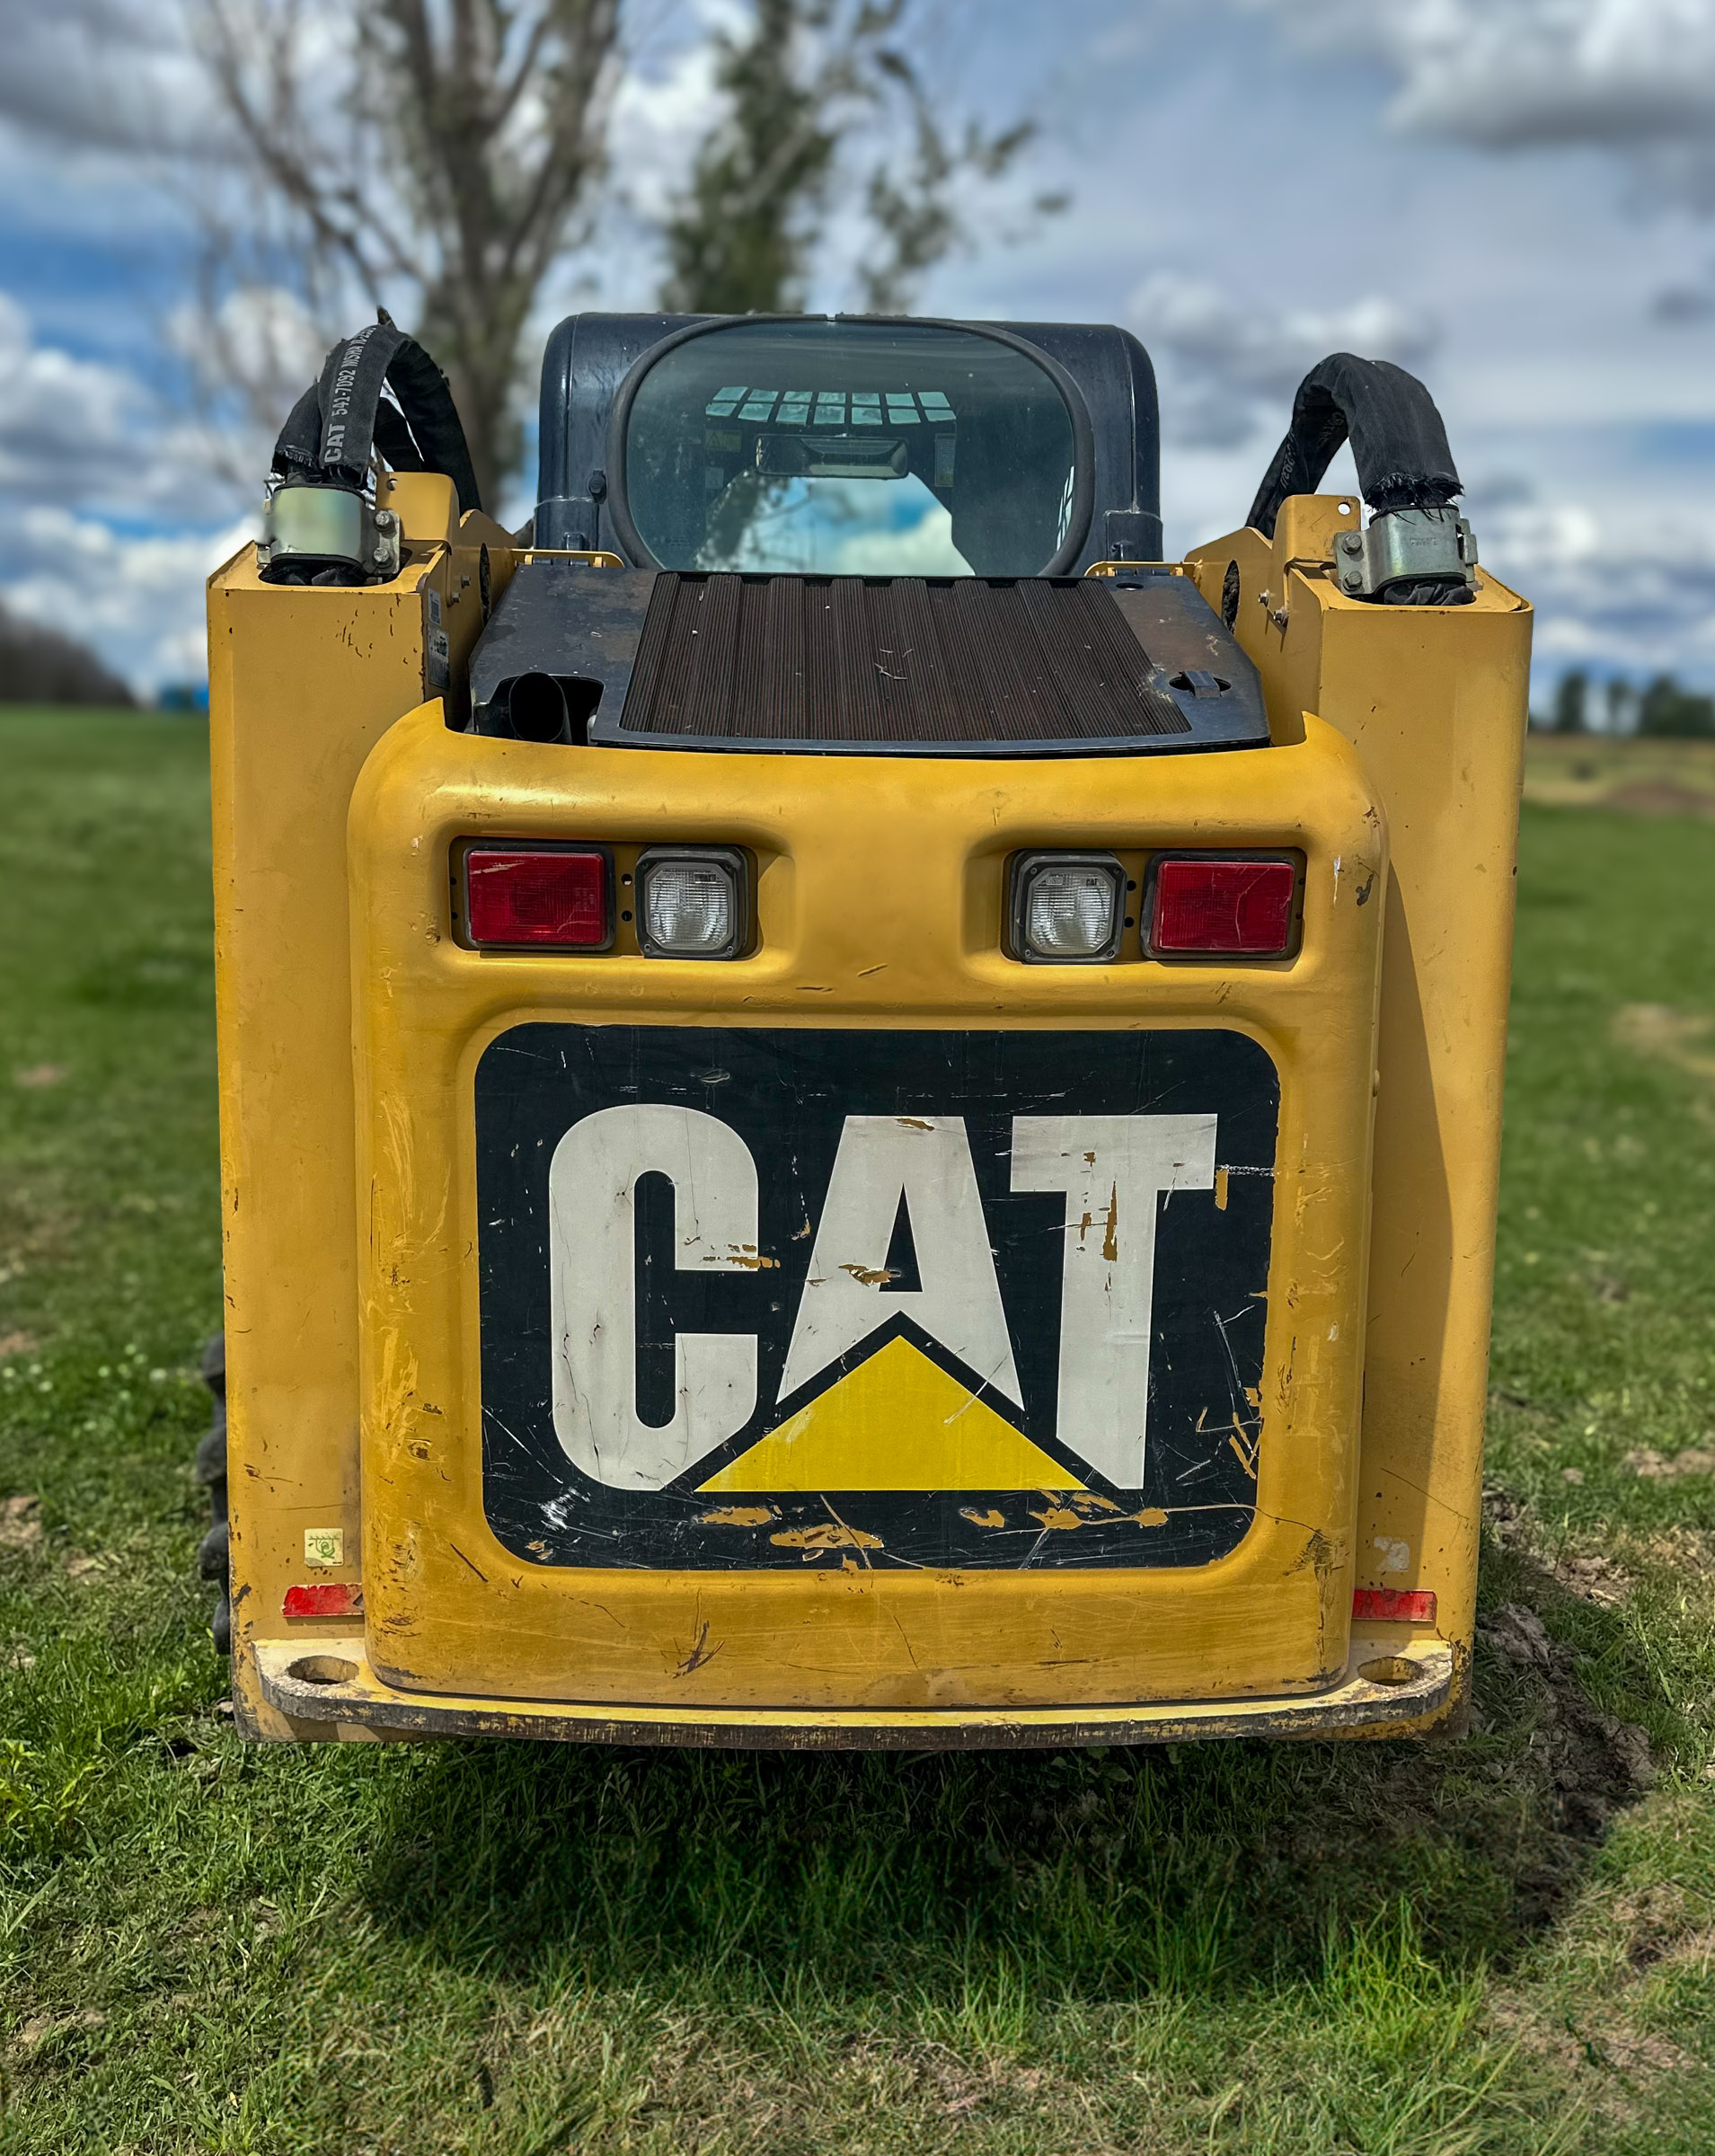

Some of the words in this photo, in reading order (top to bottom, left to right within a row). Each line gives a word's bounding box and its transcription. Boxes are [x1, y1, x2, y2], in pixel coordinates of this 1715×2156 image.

[332, 369, 357, 417] 541-7092
[324, 423, 346, 463] CAT
[549, 1104, 1218, 1491] CAT
